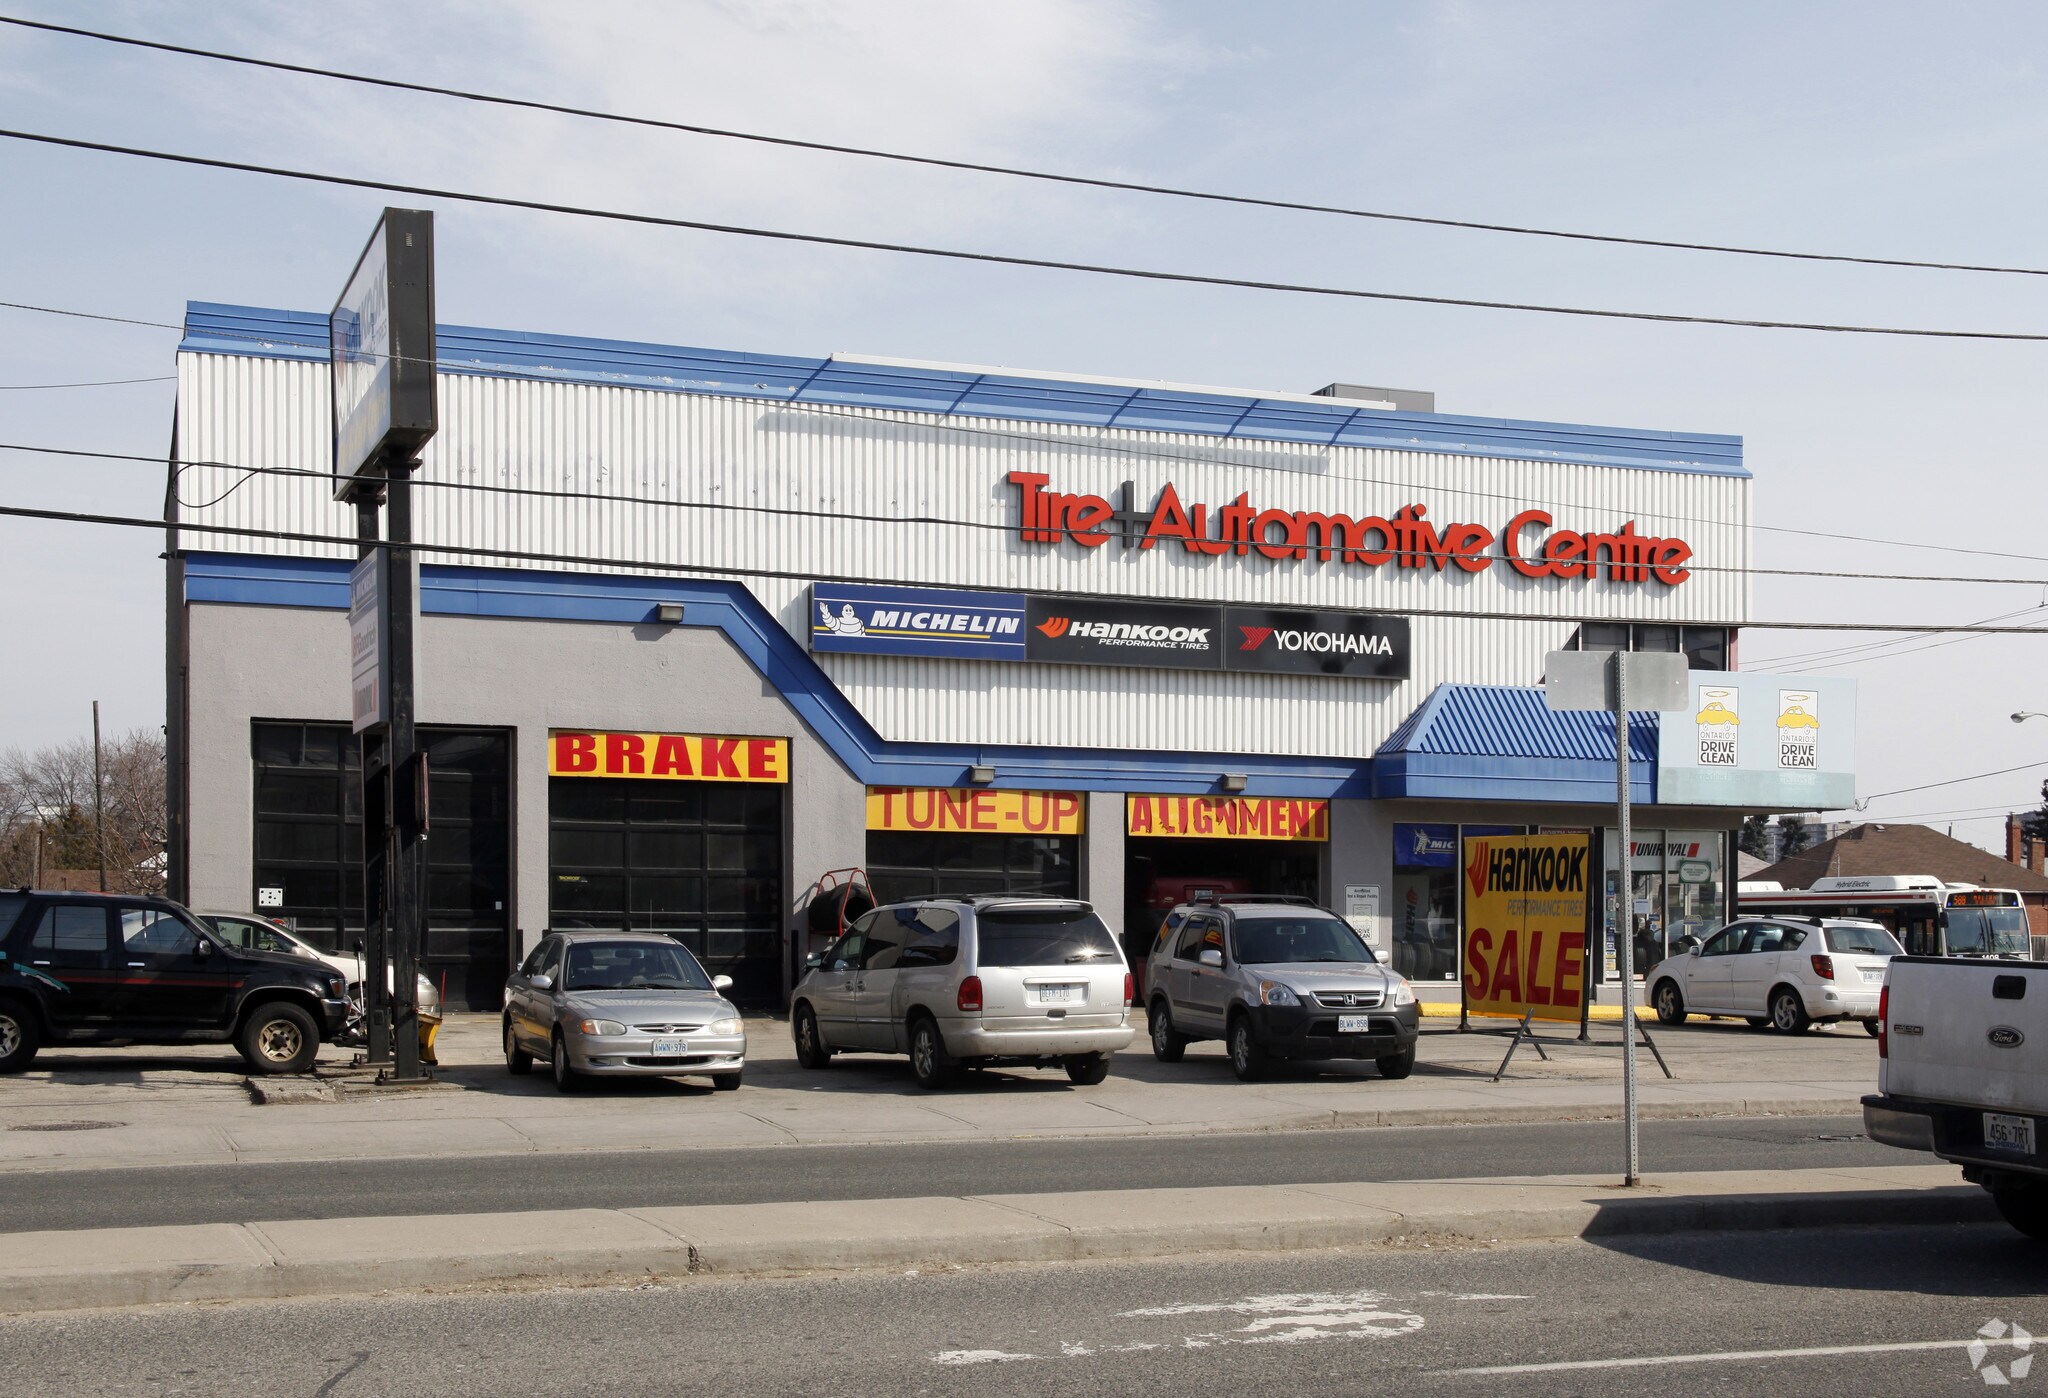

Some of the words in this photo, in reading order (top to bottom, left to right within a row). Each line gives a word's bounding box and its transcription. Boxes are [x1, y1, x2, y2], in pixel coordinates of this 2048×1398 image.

[1504, 509, 1692, 586] Centre
[870, 610, 1020, 634] MICHELIN
[1099, 638, 1178, 649] PERFORMANCE
[1180, 642, 1210, 650] TIRES
[1274, 629, 1393, 656] YOKOHAMA
[1700, 731, 1736, 740] ONTARIO'S
[1781, 735, 1816, 743] ONTARIO'S
[1700, 741, 1735, 753] DRIVE
[1781, 744, 1815, 756] DRIVE
[555, 732, 778, 779] BRAKE
[1700, 752, 1735, 764] CLEAN
[1781, 755, 1815, 767] CLEAN
[874, 787, 1079, 832] TUNE-UP
[1131, 796, 1328, 838] ALIGNMENT
[1835, 880, 1852, 889] Hybrid
[1852, 880, 1871, 888] Electric
[1507, 899, 1562, 917] PERFORMANCE
[1563, 900, 1584, 917] TIRES
[1466, 927, 1586, 1008] SALE
[1994, 1030, 2014, 1042] Ford
